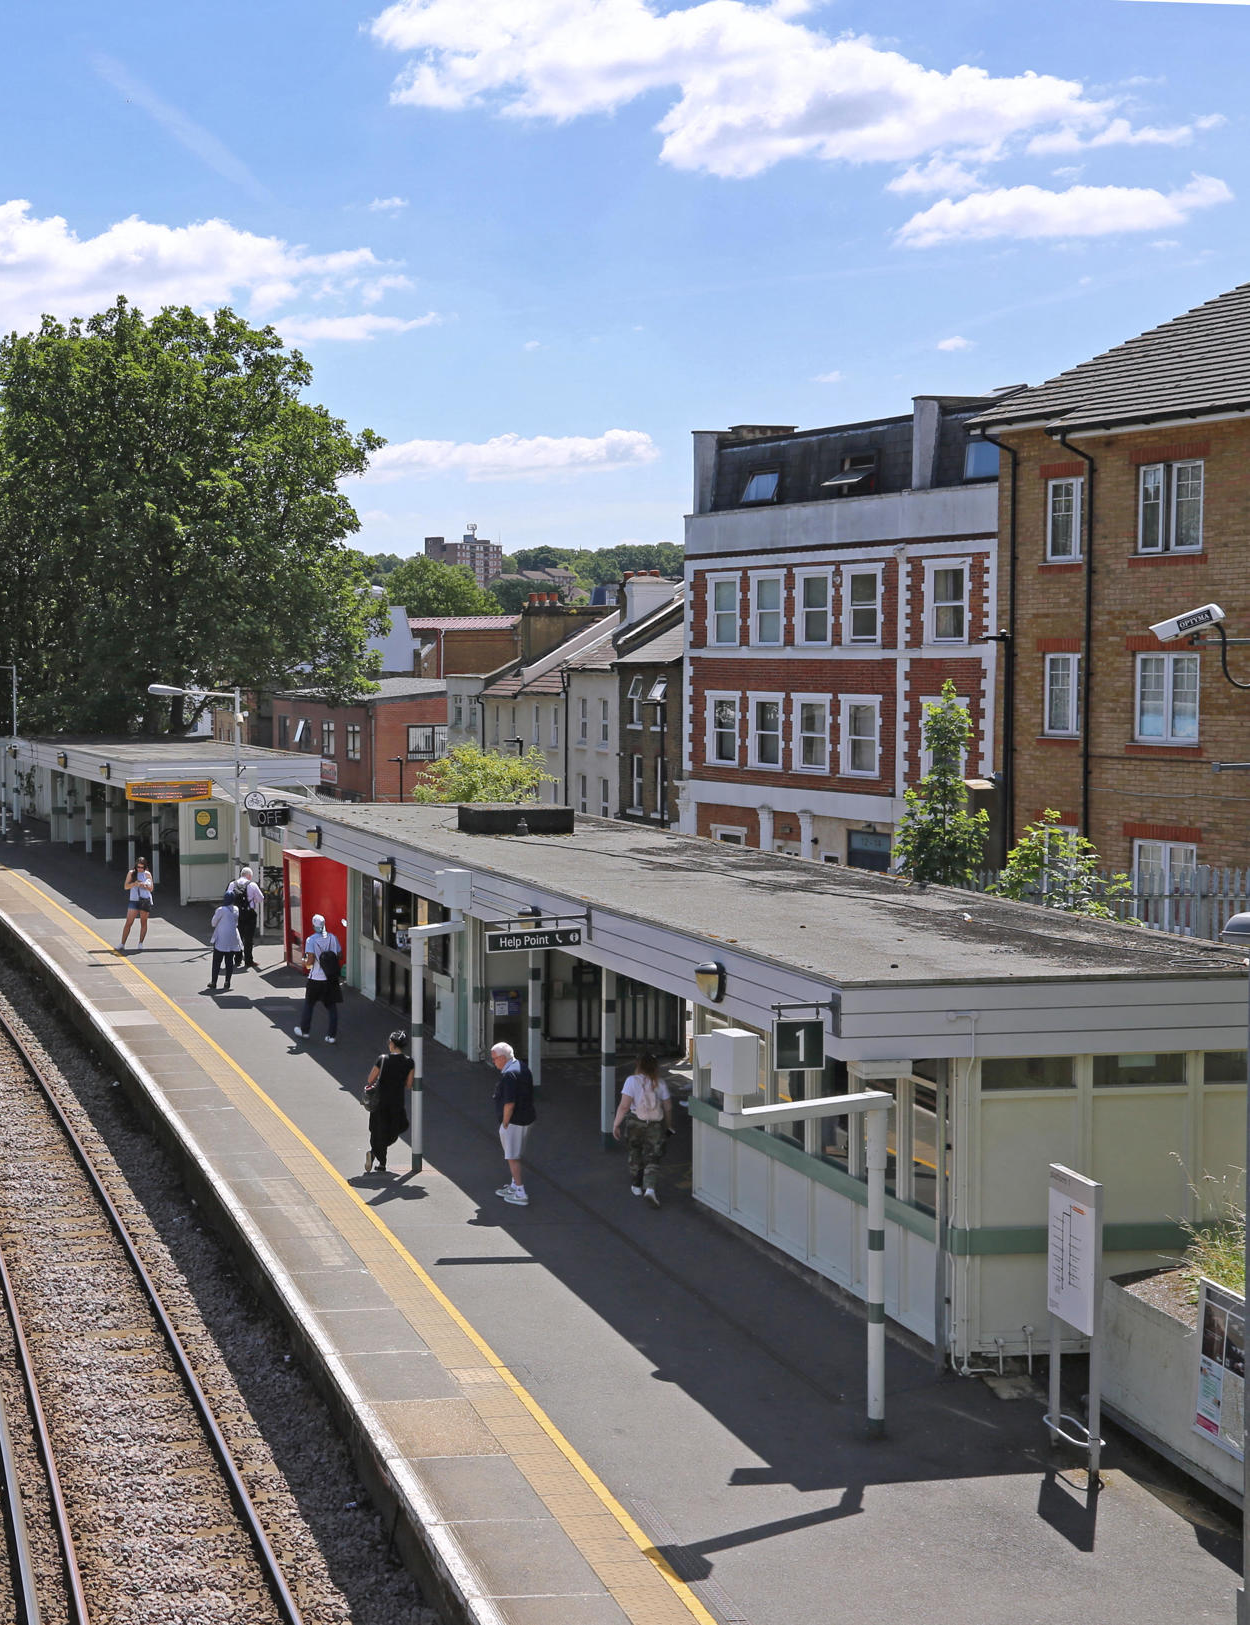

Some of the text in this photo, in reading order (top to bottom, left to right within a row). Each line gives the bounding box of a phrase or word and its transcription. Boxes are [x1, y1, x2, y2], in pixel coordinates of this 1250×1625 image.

[1179, 613, 1210, 628] OPTYMA
[257, 810, 282, 824] OFF
[499, 935, 550, 949] Help Point
[795, 1029, 805, 1062] 1
